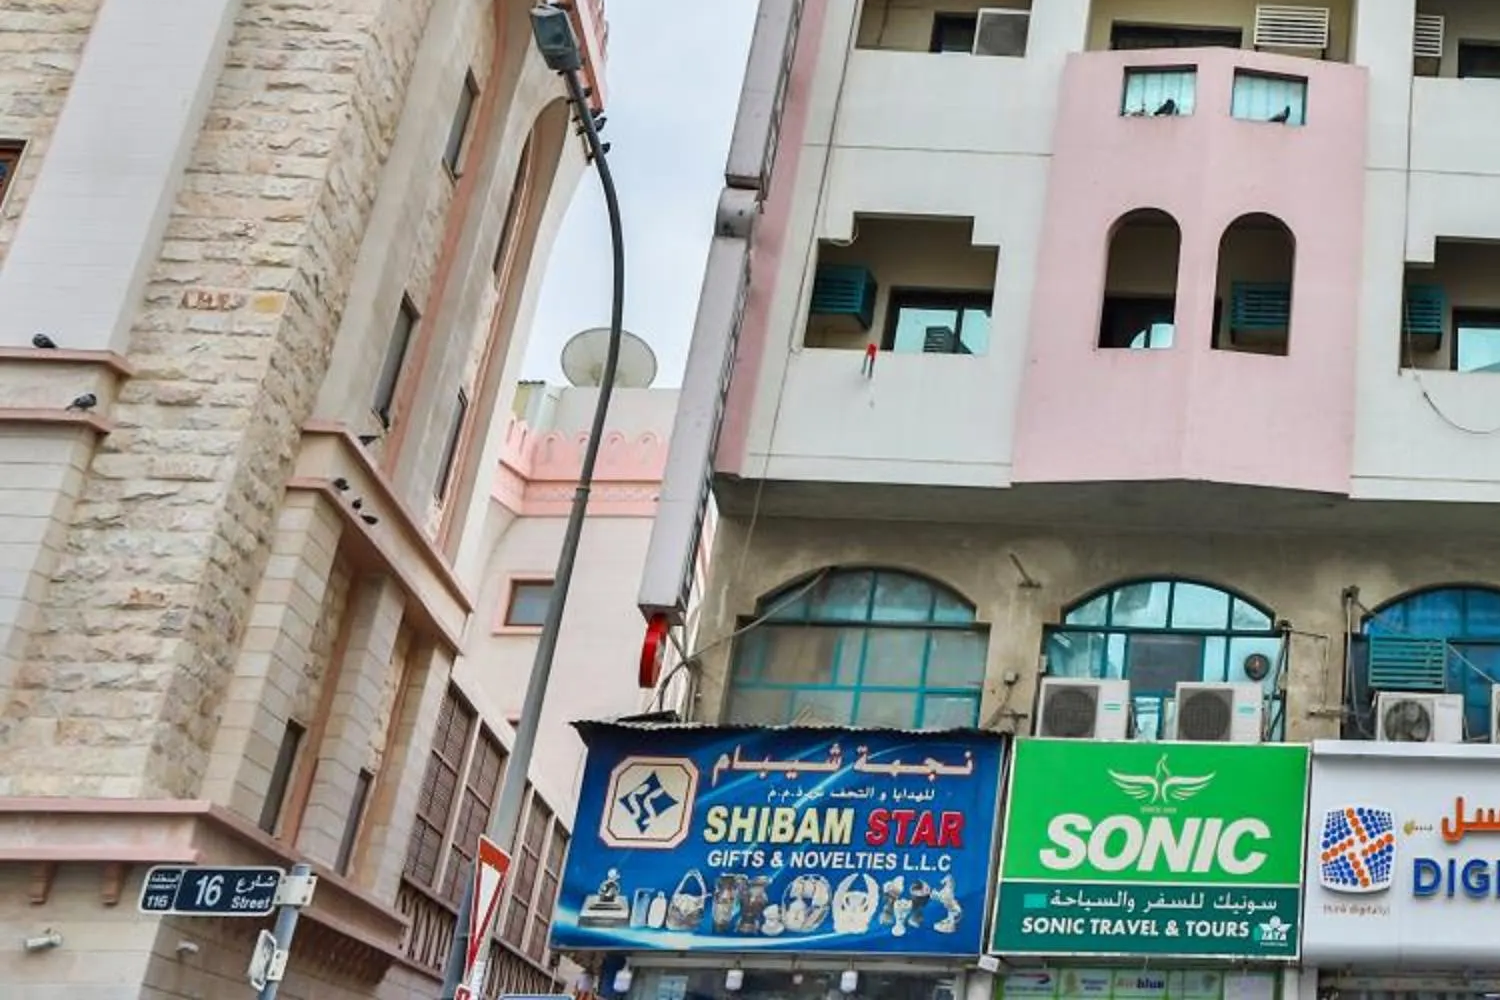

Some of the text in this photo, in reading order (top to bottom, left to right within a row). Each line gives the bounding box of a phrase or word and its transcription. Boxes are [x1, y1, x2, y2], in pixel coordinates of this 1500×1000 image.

[711, 743, 974, 788] نجمة شيبام
[704, 806, 966, 847] SHIBAM STAR
[1039, 813, 1272, 875] SONIC
[708, 851, 765, 868] GIFTS
[770, 851, 784, 868] &
[790, 852, 897, 869] NOVELTIES
[195, 875, 225, 907] 16
[235, 874, 276, 893] شارع
[231, 895, 271, 909] Street
[1051, 889, 1278, 914] سونيك للسفر والسياحة
[1022, 917, 1249, 938] SONIC TRAVEL & TOURS
